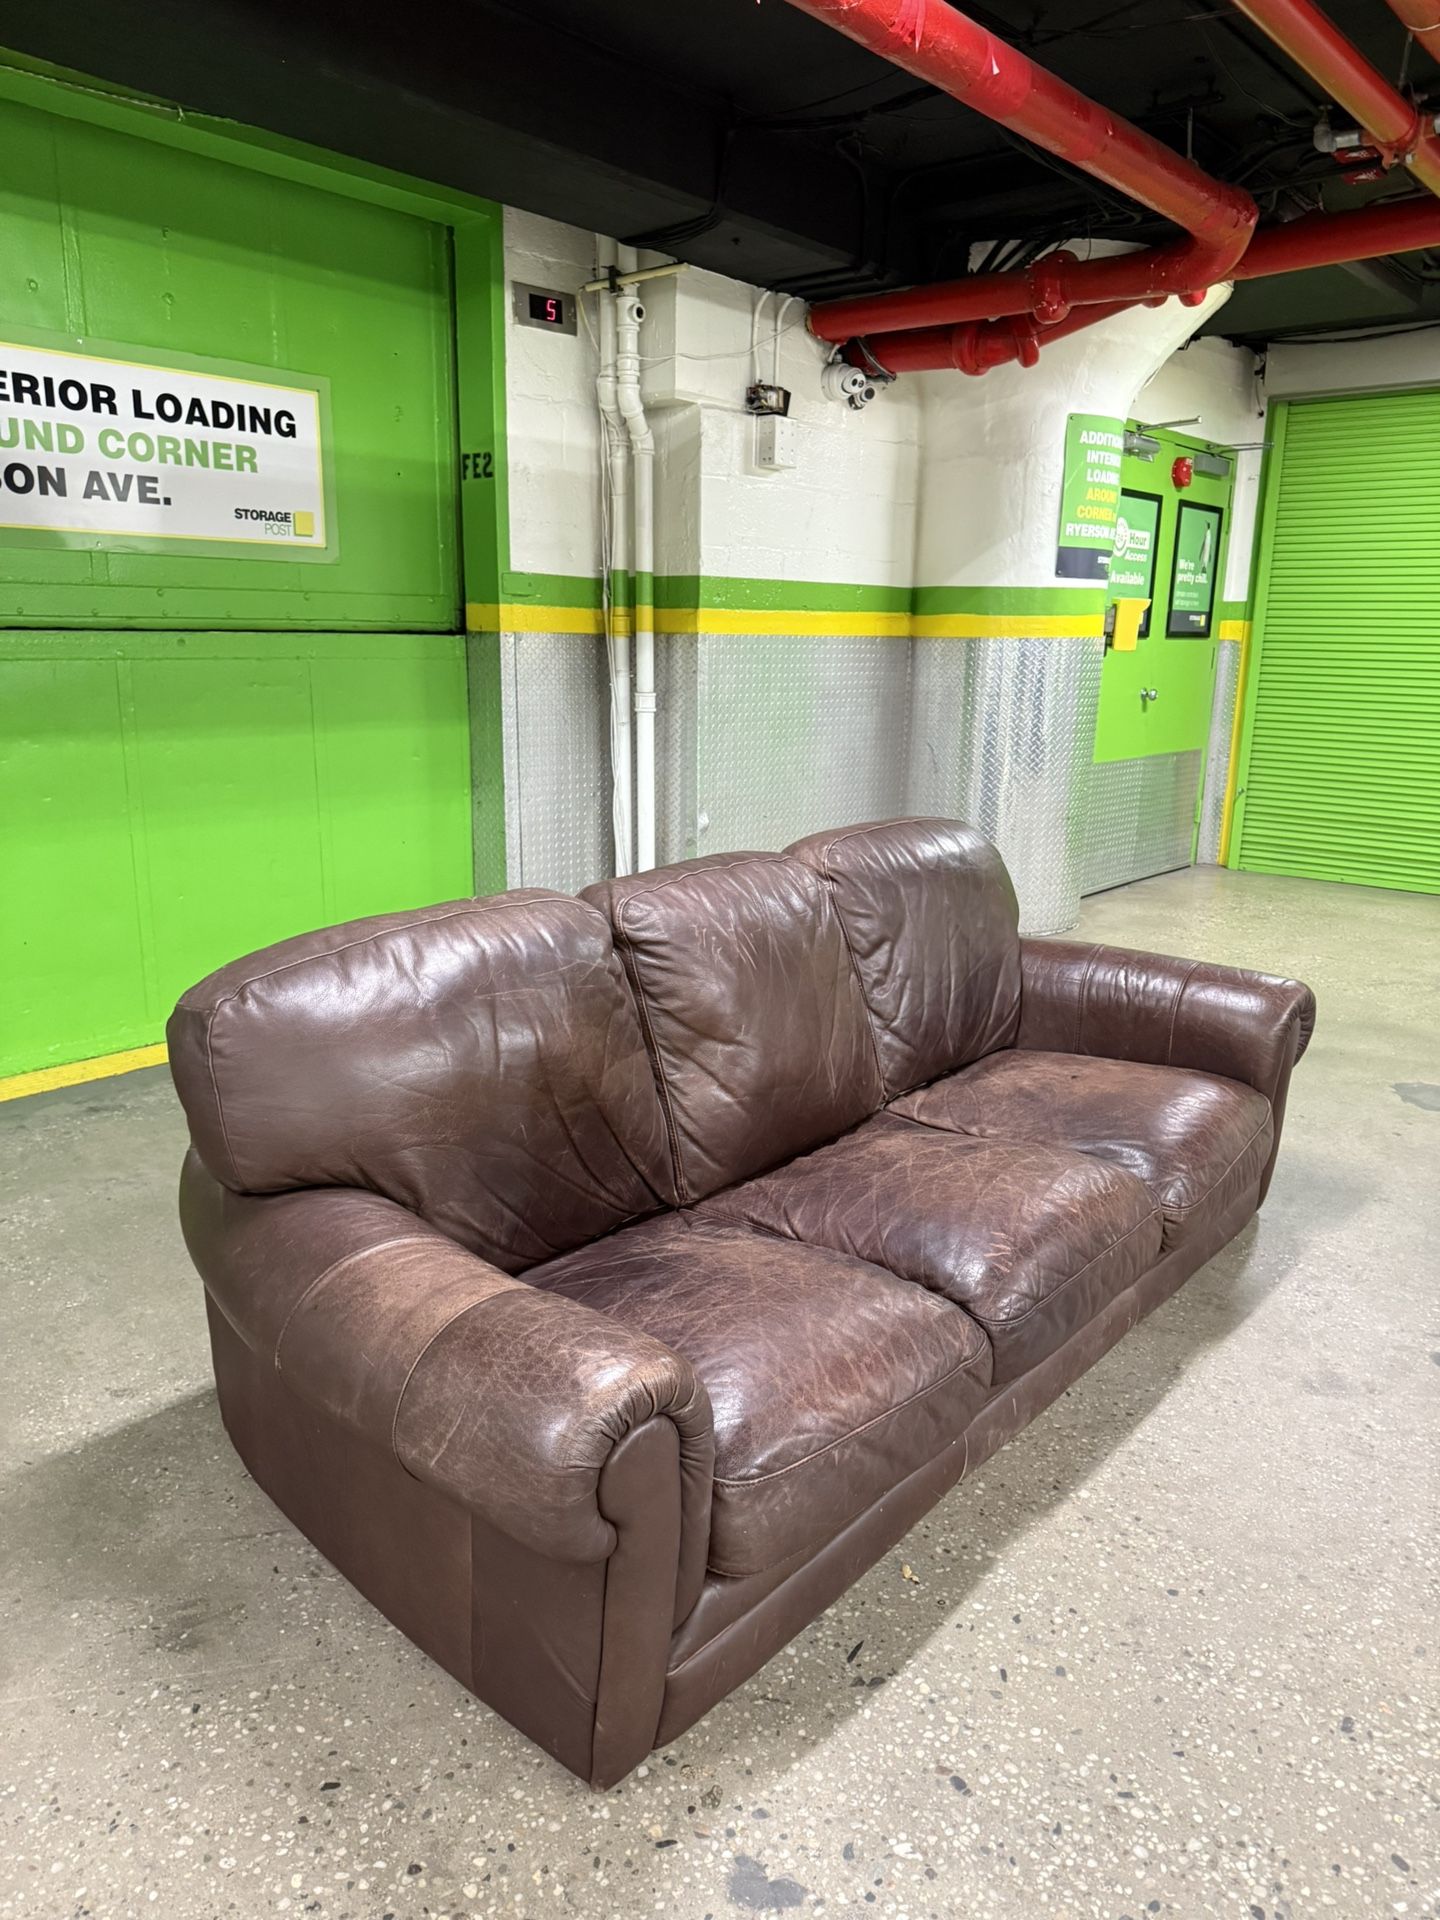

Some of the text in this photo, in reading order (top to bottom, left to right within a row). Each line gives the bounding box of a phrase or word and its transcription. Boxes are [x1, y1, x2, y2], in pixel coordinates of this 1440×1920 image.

[546, 299, 556, 321] 5
[132, 388, 297, 439] LOADING
[98, 427, 258, 473] CORNER
[462, 452, 494, 481] FE2
[0, 462, 172, 506] ON AVE.
[234, 507, 292, 523] STORAGE
[264, 522, 292, 536] POST
[1129, 531, 1148, 547] Hour
[1125, 549, 1148, 562] Access
[1109, 570, 1146, 586] Available
